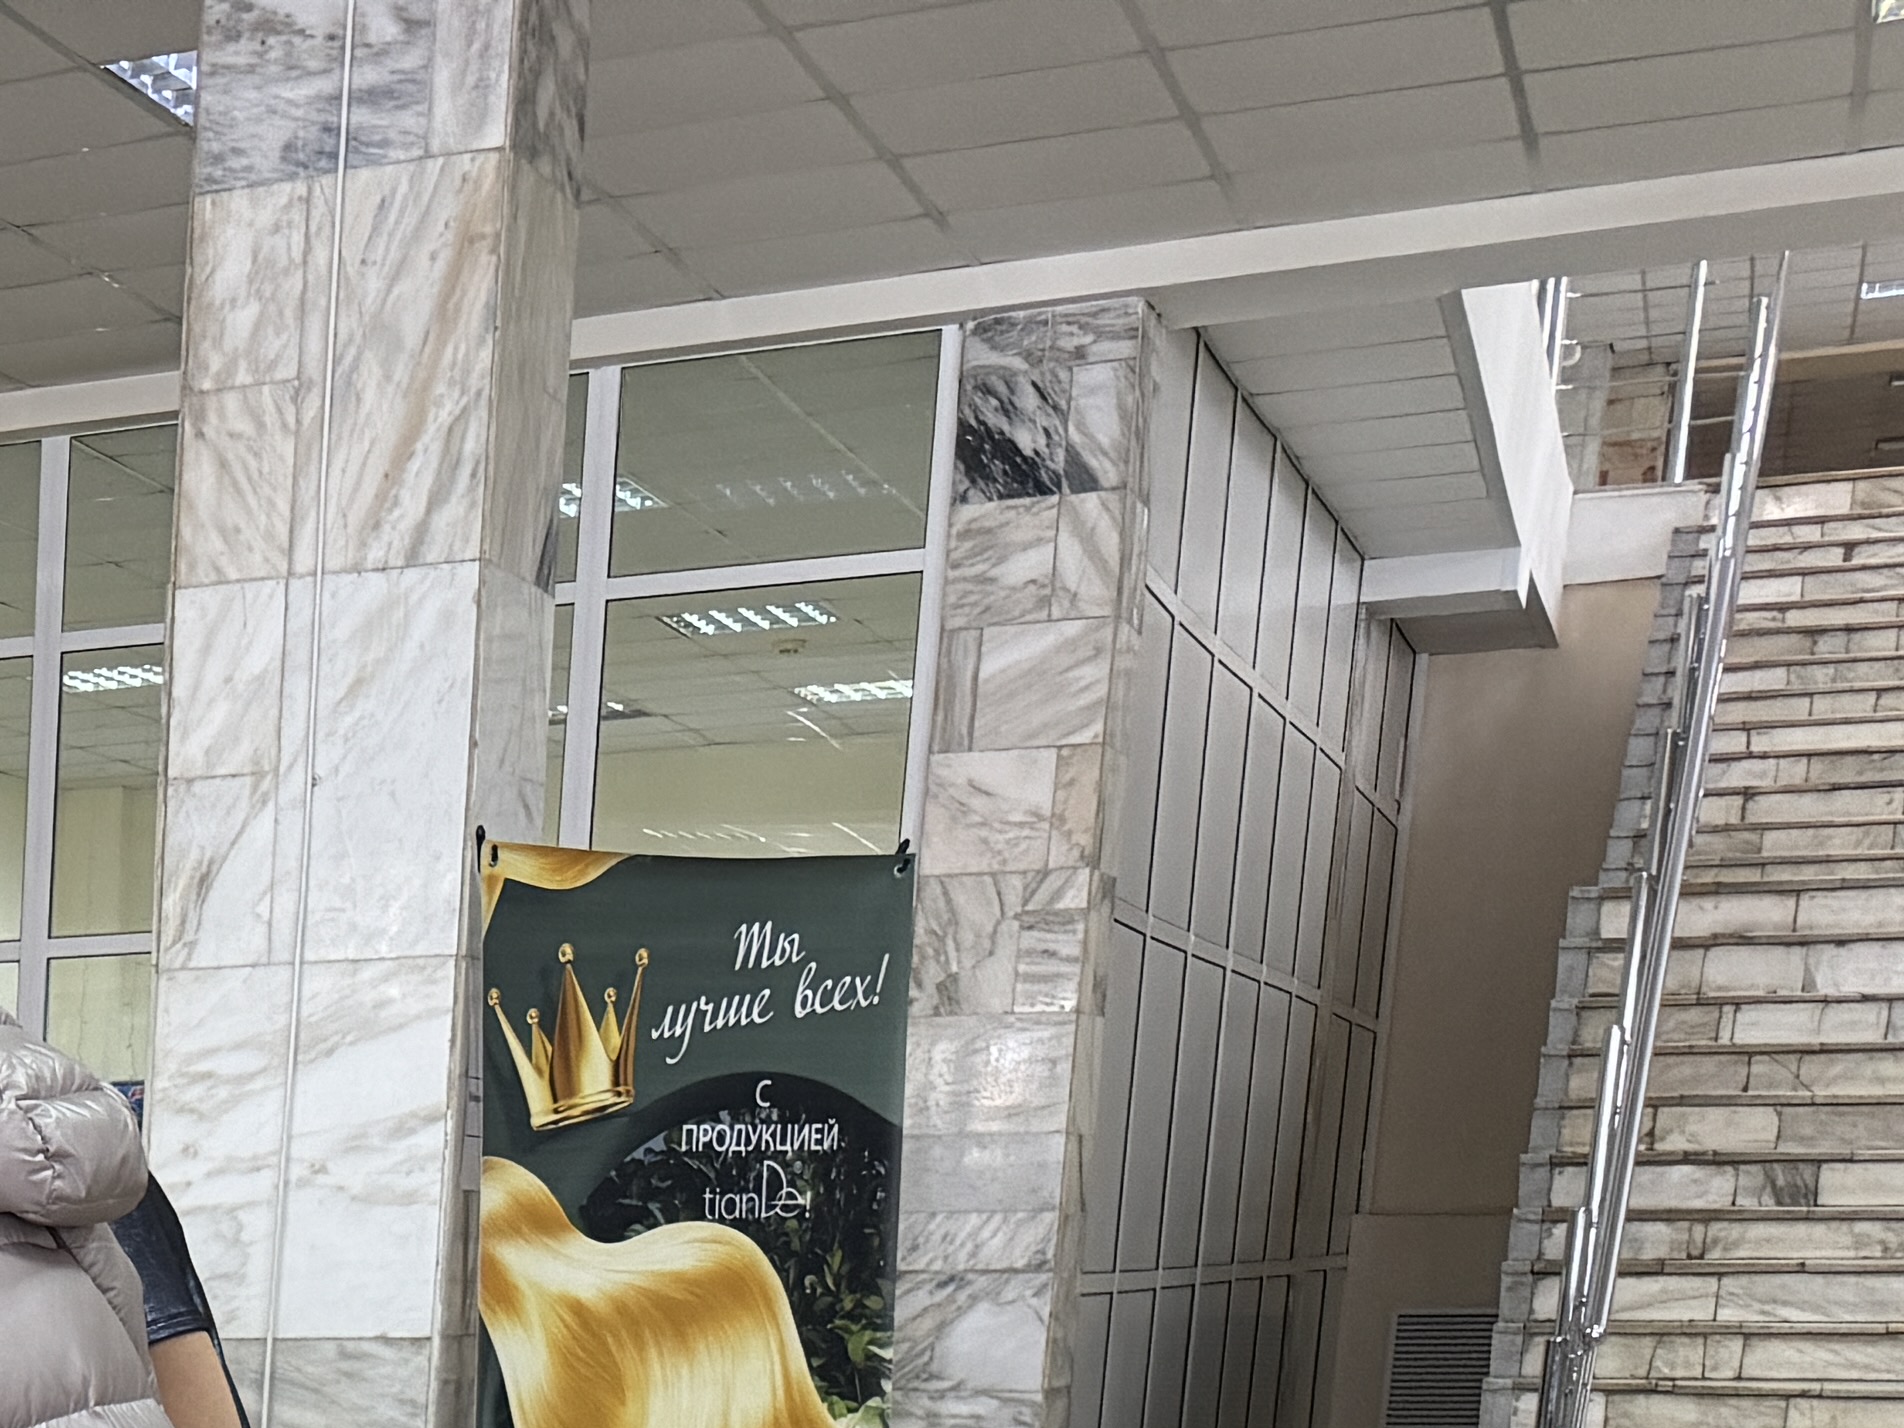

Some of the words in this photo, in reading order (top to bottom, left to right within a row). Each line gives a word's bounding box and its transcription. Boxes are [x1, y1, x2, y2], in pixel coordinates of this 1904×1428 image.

[734, 920, 806, 971] Ты
[651, 988, 774, 1065] лучше
[794, 953, 890, 1019] всех!
[755, 1079, 772, 1107] С
[681, 1118, 839, 1157] ПРОДУКЦИЕЙ
